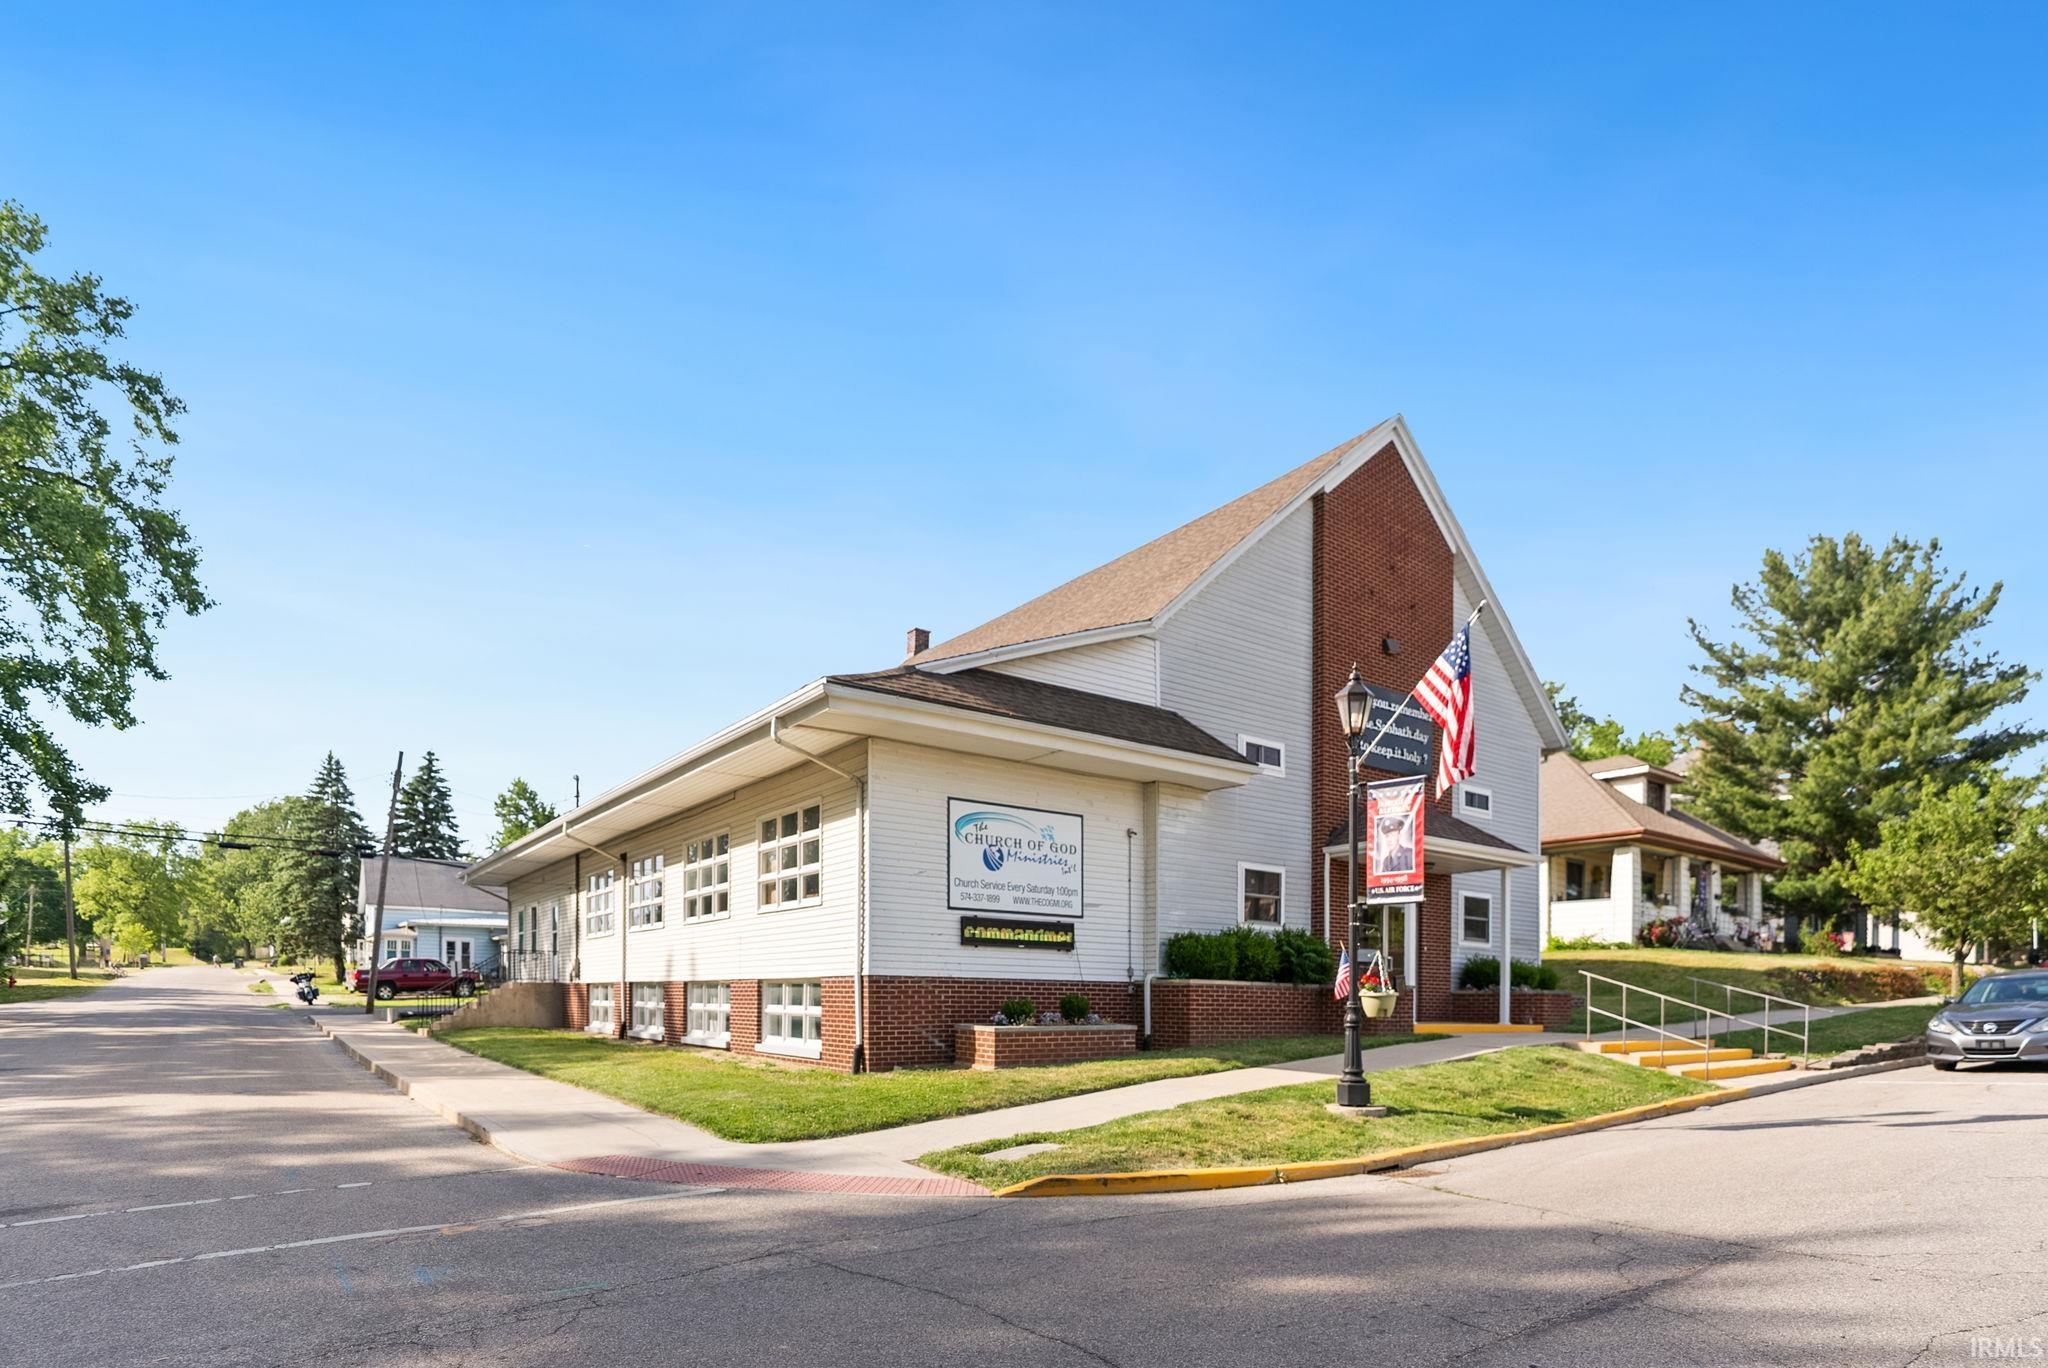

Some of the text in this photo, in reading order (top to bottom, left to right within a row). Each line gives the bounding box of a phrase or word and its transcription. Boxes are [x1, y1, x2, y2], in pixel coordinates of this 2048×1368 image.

[1372, 698, 1388, 710] you
[1375, 718, 1412, 738] Sbbath
[1413, 728, 1430, 745] day
[1360, 740, 1370, 751] to
[1394, 746, 1402, 758] it
[1403, 748, 1423, 766] holy
[974, 821, 989, 833] The
[964, 832, 1078, 855] CHURCH OF GOD
[1006, 849, 1068, 867] Ministries
[954, 877, 979, 889] Church
[980, 879, 1006, 891] Service
[1007, 881, 1026, 894] Every
[1026, 883, 1054, 896] Saturday
[1396, 884, 1415, 893] FORCE
